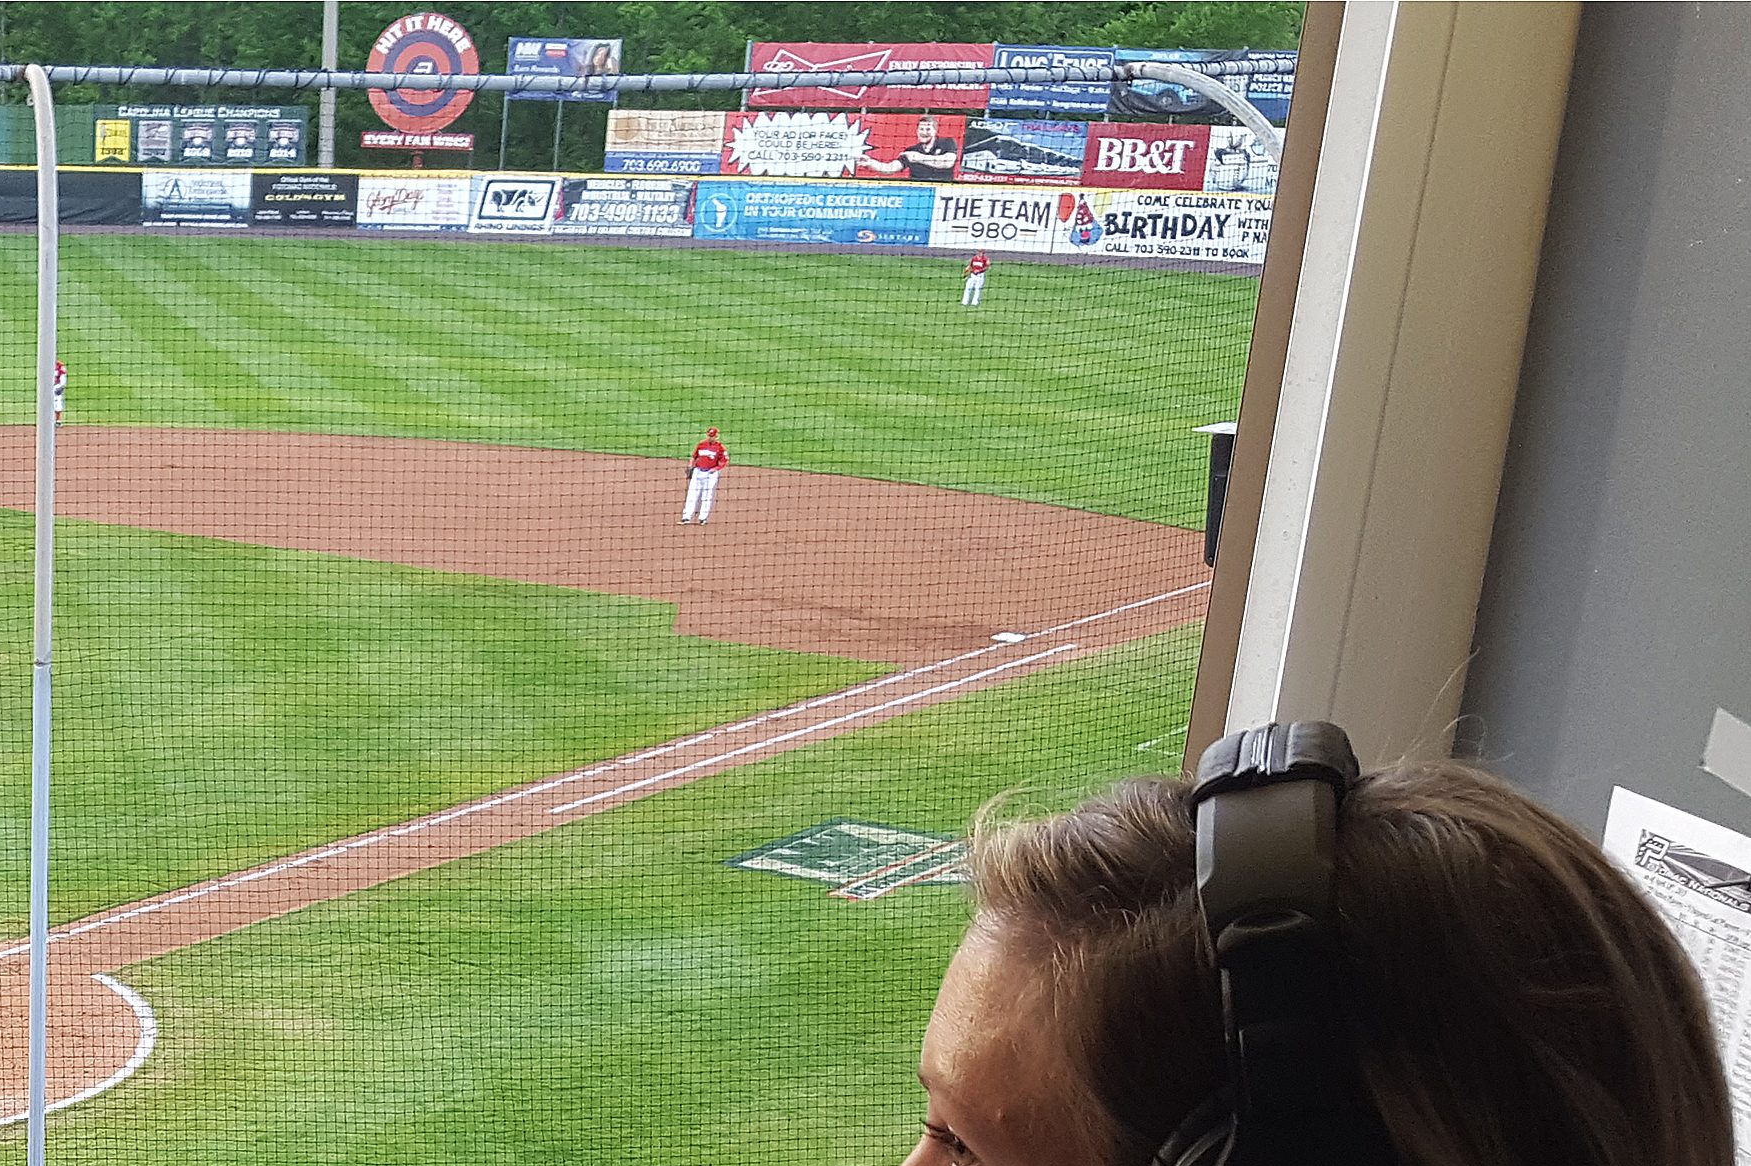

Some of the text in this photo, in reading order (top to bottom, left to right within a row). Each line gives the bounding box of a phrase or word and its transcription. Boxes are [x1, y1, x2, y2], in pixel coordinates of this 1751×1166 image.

[375, 15, 471, 54] HIT IT HERE
[217, 107, 281, 118] CHAMPIONS
[783, 131, 795, 139] AD
[758, 140, 793, 149] COULD
[796, 141, 808, 149] BE
[748, 151, 774, 161] CALL
[1093, 137, 1195, 175] BB&T
[746, 192, 904, 208] ORTHOPEDIC EXCELLENCE
[1137, 194, 1241, 210] COME CELEBRATE
[569, 203, 680, 224] 703-490-1133
[743, 206, 759, 217] IN
[761, 206, 797, 218] YOUR
[940, 195, 1051, 229] THE TEAM
[970, 221, 1018, 240] 980
[1103, 211, 1231, 240] BIRTHDAY
[1237, 217, 1269, 231] WITH
[1105, 242, 1130, 253] CALL
[1134, 243, 1154, 254] 703
[1205, 246, 1219, 257] TO
[1222, 247, 1250, 259] BOOK
